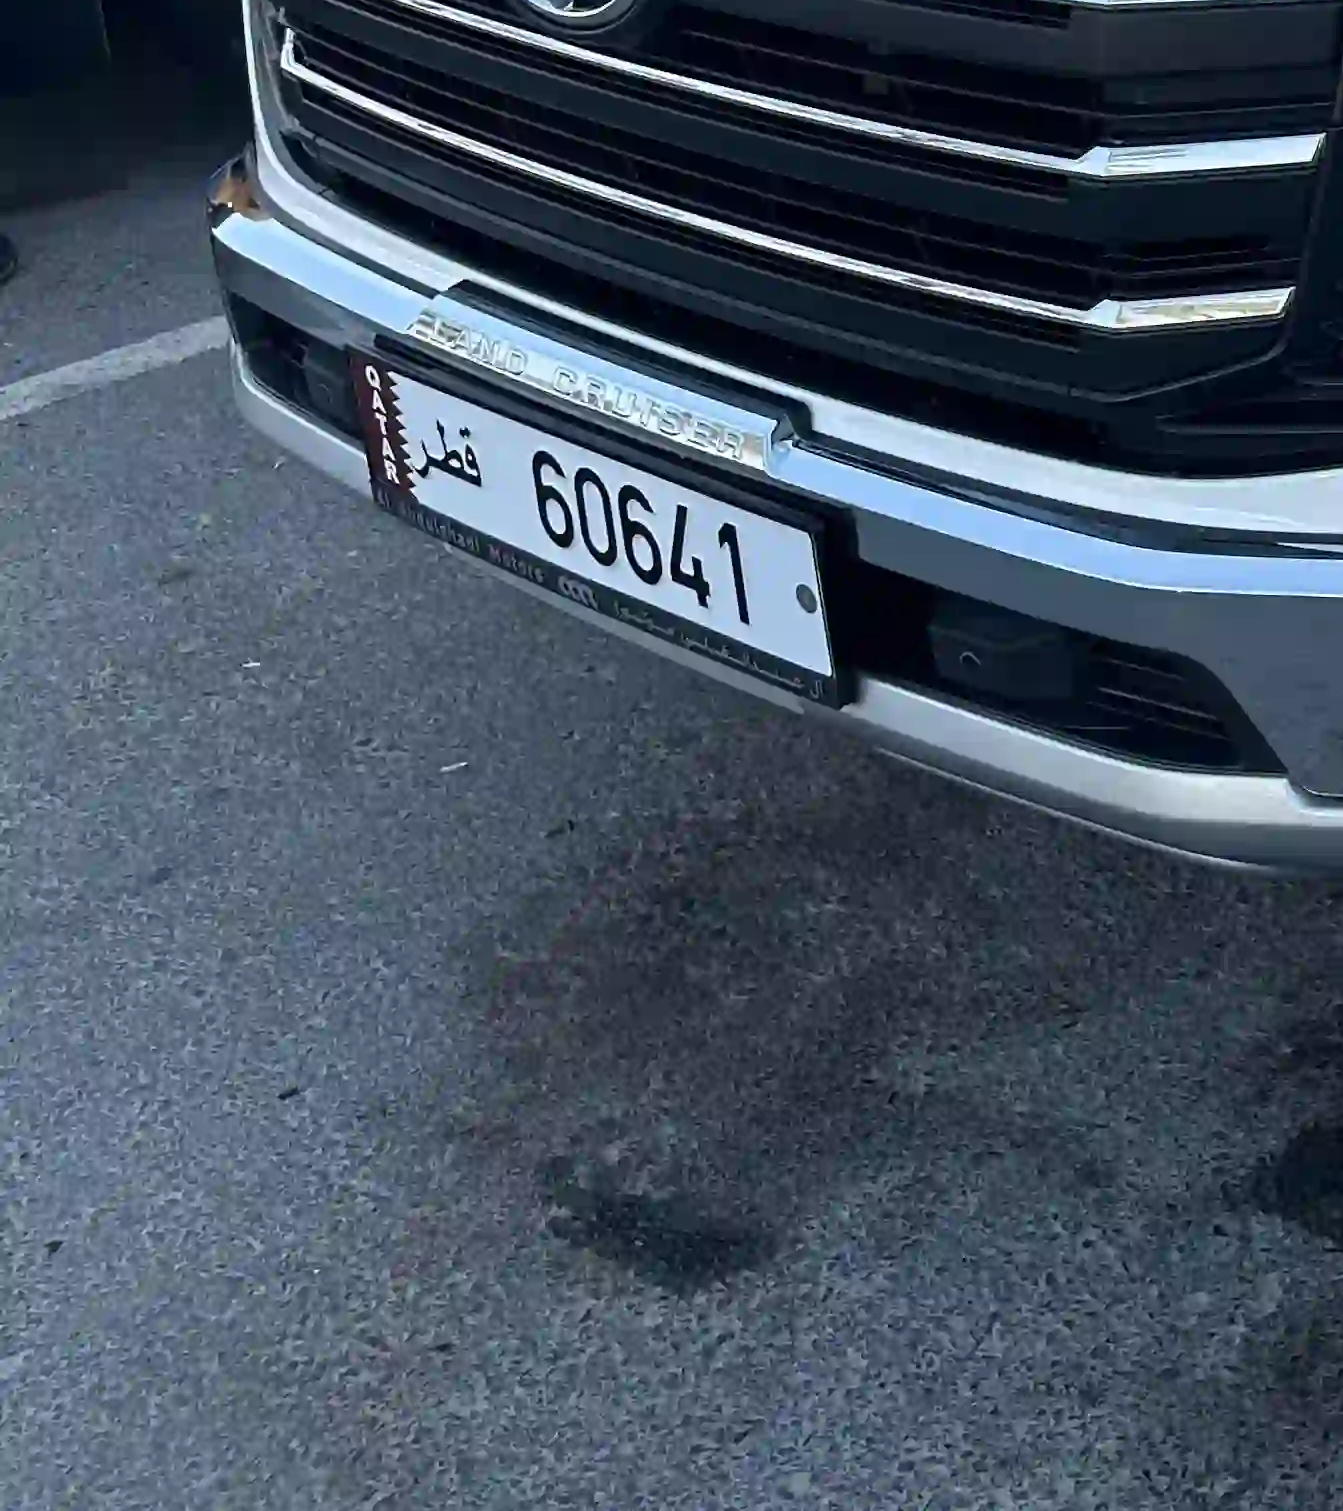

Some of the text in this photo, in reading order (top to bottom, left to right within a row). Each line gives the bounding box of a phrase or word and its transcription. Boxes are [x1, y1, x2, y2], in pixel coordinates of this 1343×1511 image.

[364, 364, 400, 485] QATAR
[412, 418, 482, 488] قطر
[425, 318, 744, 459] LAND CRUISER
[531, 449, 751, 626] 60641
